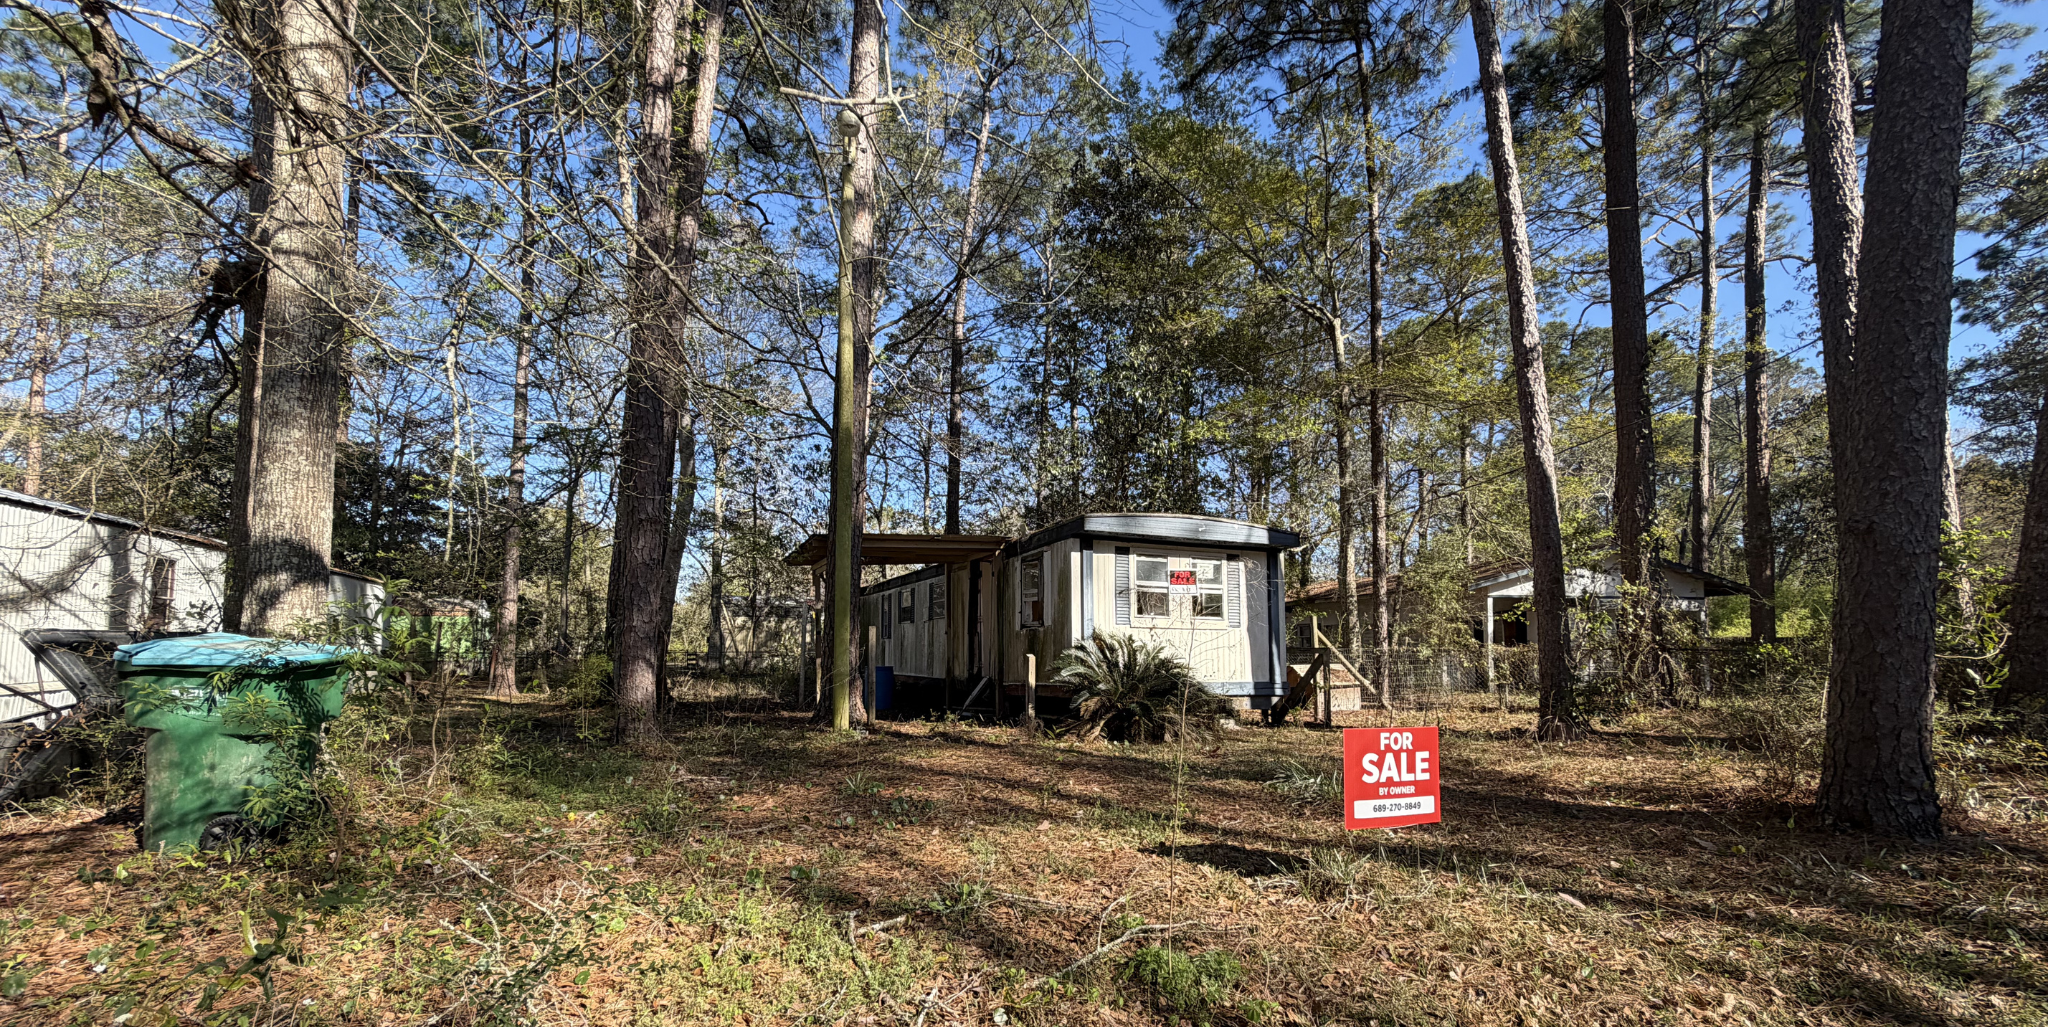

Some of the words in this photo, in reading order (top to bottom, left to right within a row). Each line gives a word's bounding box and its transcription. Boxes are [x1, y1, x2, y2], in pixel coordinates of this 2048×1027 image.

[1170, 577, 1195, 585] SALE
[1380, 732, 1413, 751] FOR
[1361, 750, 1431, 784] SALE
[1379, 787, 1388, 796] BY
[1390, 785, 1415, 795] OWNER
